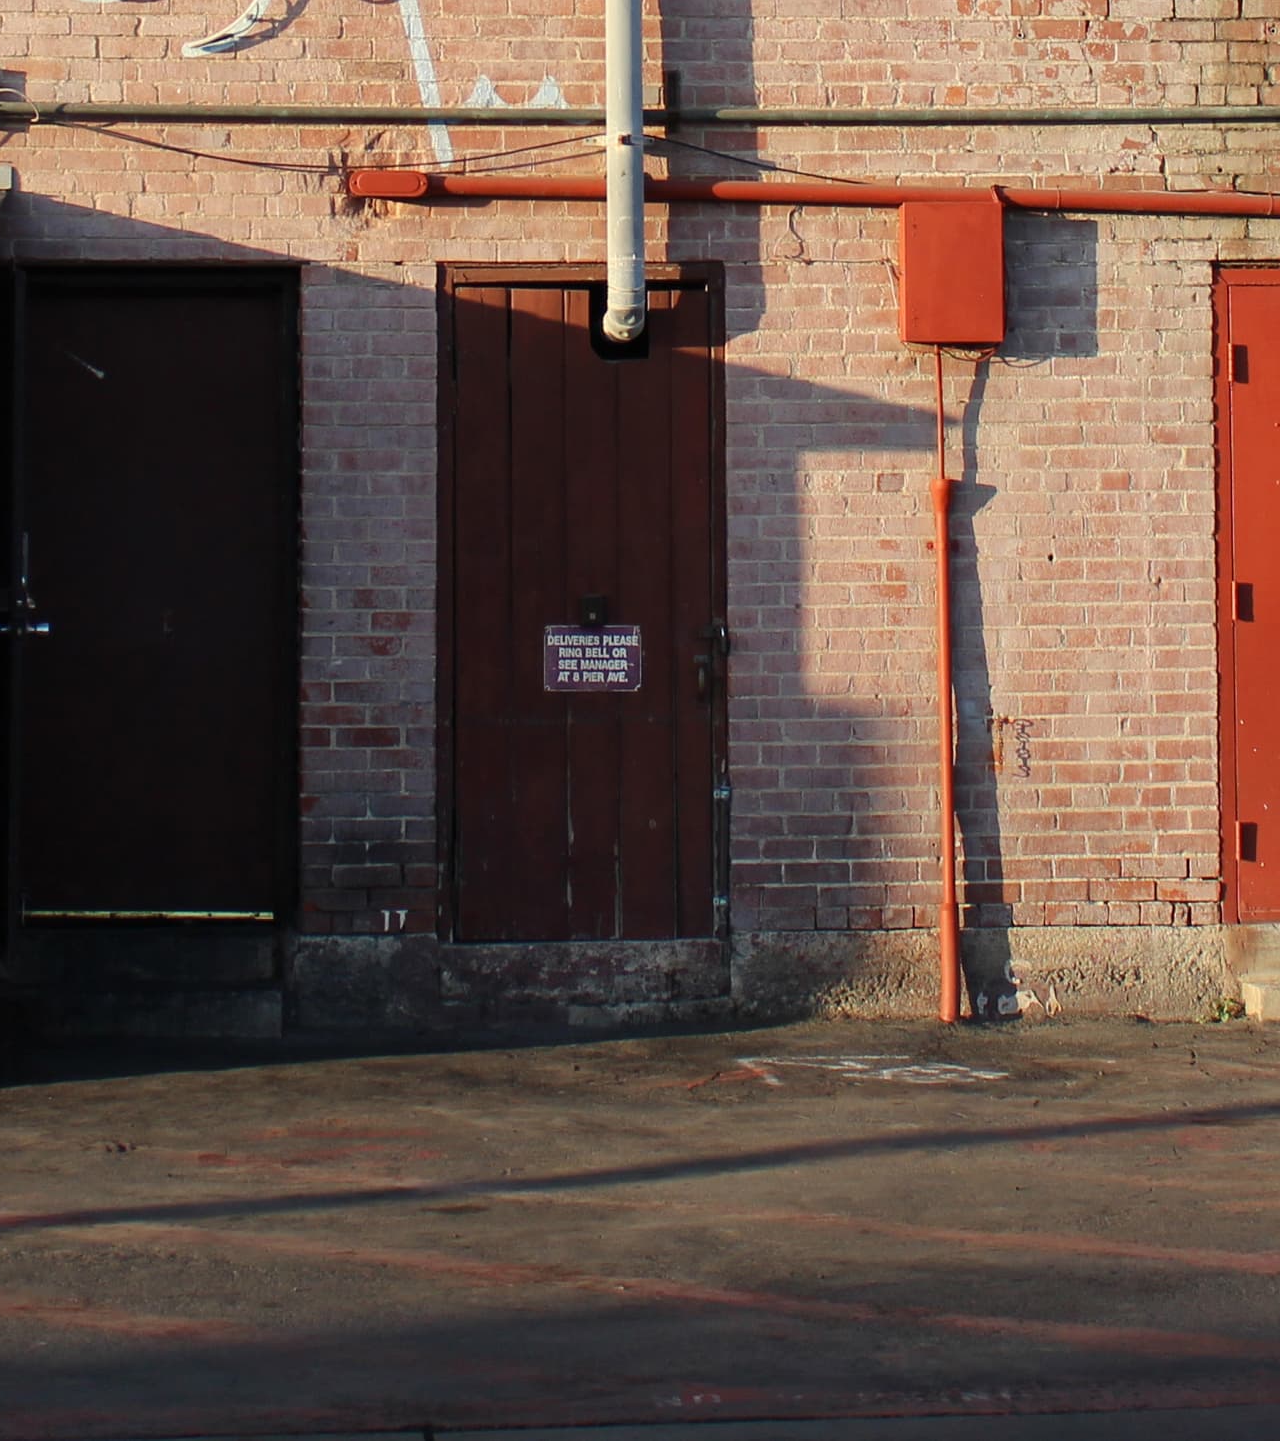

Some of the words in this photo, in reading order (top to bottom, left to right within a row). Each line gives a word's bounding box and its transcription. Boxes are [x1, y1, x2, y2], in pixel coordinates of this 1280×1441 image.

[547, 636, 600, 646] DELIVERIES
[602, 636, 638, 646] PLEASE
[558, 648, 582, 658] RING
[585, 648, 609, 658] BELL
[612, 648, 627, 658] OR
[558, 660, 577, 670] SEE
[580, 660, 628, 670] MANAGER
[557, 672, 570, 682] AT
[582, 672, 604, 682] PIER
[607, 672, 628, 682] AVE.
